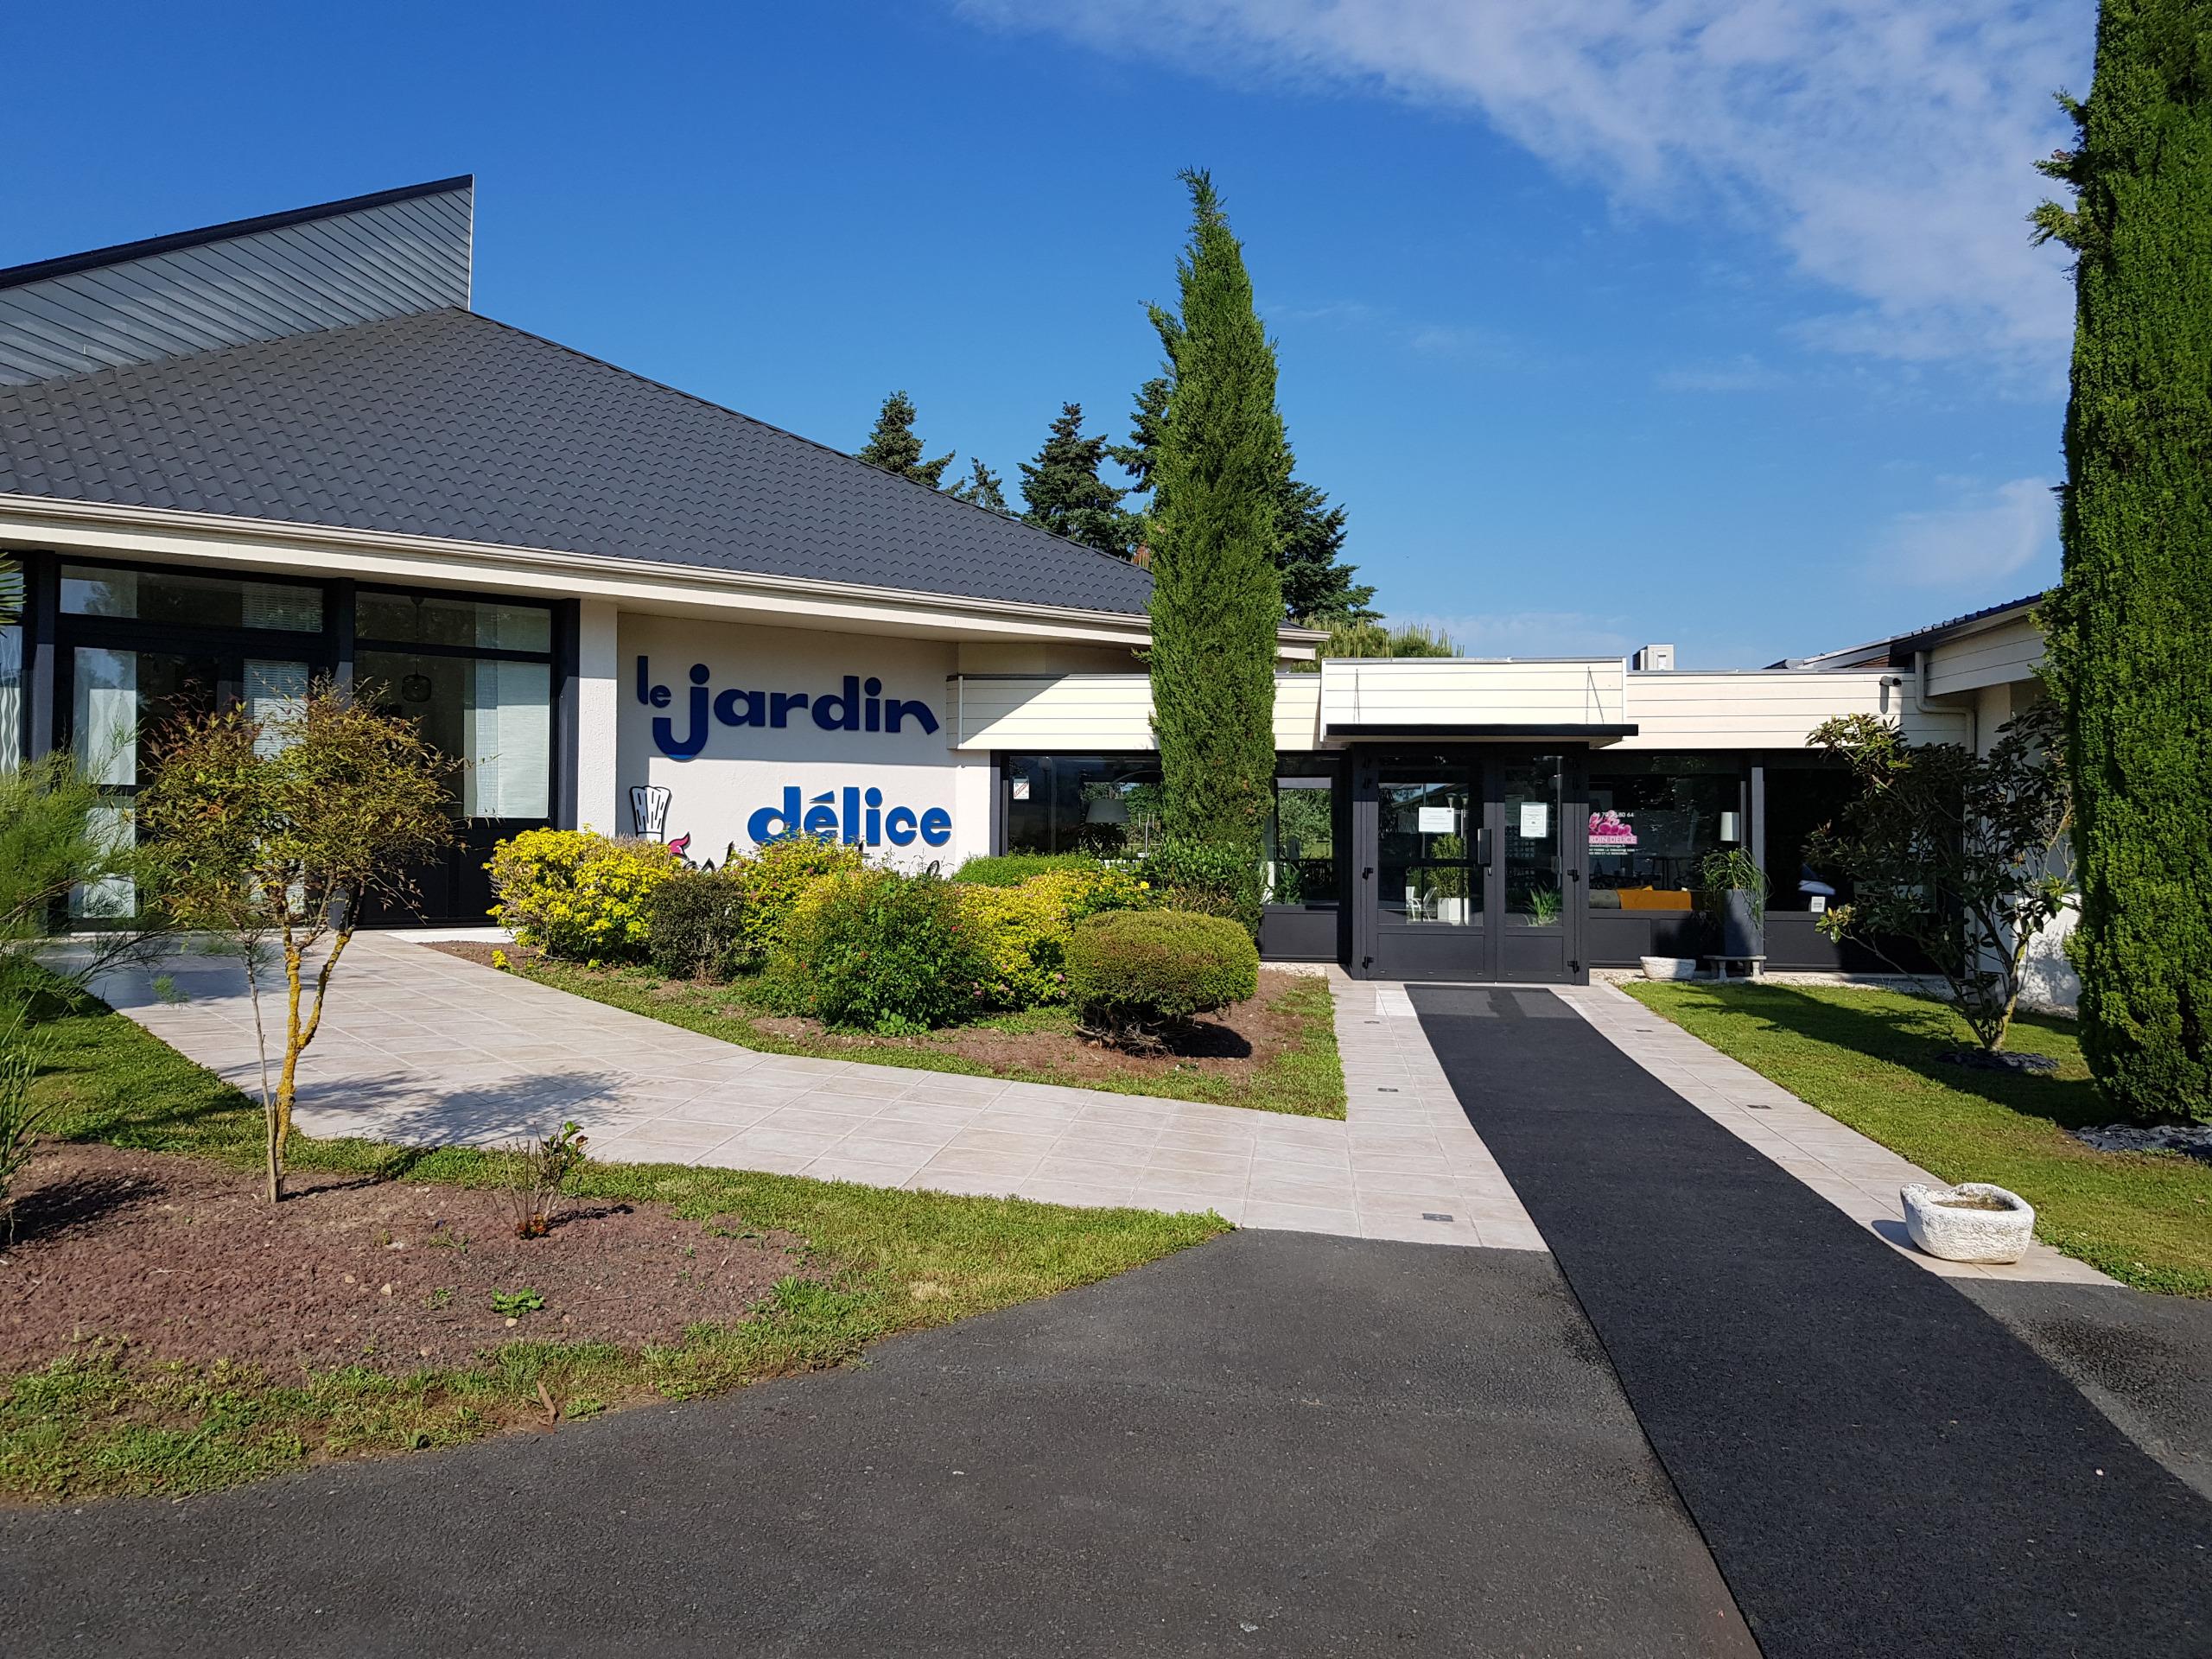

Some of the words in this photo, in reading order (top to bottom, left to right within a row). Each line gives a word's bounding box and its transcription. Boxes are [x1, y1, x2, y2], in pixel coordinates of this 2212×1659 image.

[637, 655, 671, 709] le
[652, 663, 940, 760] jardin
[747, 785, 951, 847] délice
